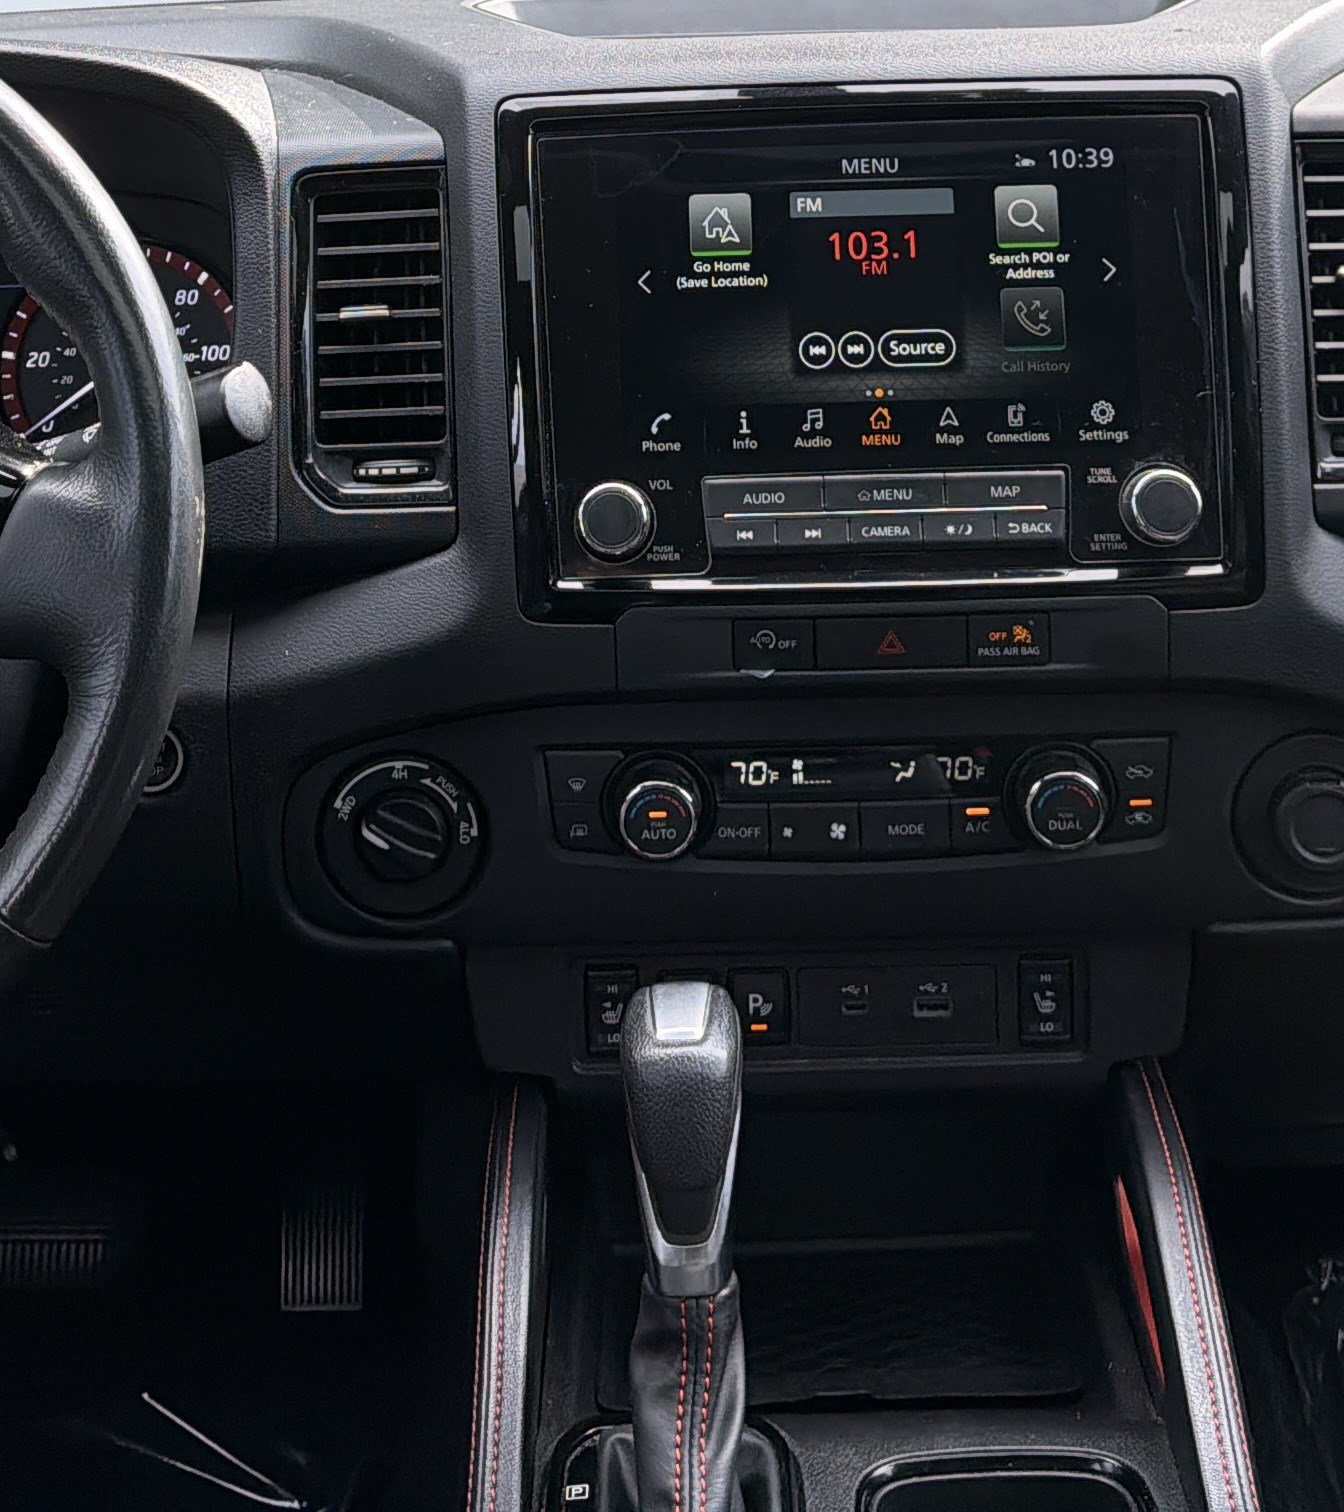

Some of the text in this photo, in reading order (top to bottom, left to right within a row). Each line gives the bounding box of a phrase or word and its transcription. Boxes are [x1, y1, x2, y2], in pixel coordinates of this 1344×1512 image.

[1048, 148, 1114, 169] 10:39
[841, 158, 899, 174] MENU
[796, 197, 823, 212] FM
[828, 230, 917, 261] 103.1
[989, 251, 1070, 266] Search POI or
[693, 259, 751, 273] Go Home
[862, 261, 888, 275] FM
[1006, 267, 1055, 280] Address
[676, 273, 769, 290] (Save Location)
[175, 289, 198, 305] 80
[63, 347, 76, 357] 40
[201, 345, 231, 362] 100
[889, 339, 945, 356] Source
[26, 351, 51, 368] 20
[1002, 359, 1071, 374] Call History
[60, 375, 73, 384] 20
[794, 435, 832, 448] Audio
[862, 433, 901, 446] MENU
[936, 432, 964, 446] Map
[987, 430, 1050, 443] Connections
[1079, 428, 1129, 443] Settings
[642, 439, 681, 453] Phone
[732, 437, 758, 450] Info
[1090, 467, 1112, 476] TUNE
[649, 479, 673, 490] VOL
[1086, 475, 1118, 484] SCROLL
[743, 492, 785, 505] AUDIO
[873, 488, 913, 501] MENU
[990, 486, 1021, 498] MAP
[862, 526, 910, 536] CAMERA
[1021, 522, 1053, 534] BACK
[1094, 533, 1122, 542] ENTER
[653, 545, 674, 553] PUSH
[1090, 541, 1128, 551] SETTING
[646, 552, 681, 561] POWER
[988, 632, 1008, 642] OFF
[778, 640, 797, 650] OFF
[978, 646, 1041, 656] PASS AIR BAG
[391, 769, 408, 780] 4H
[436, 775, 460, 798] PUSH
[338, 795, 357, 821] 2WD
[887, 824, 925, 836] MODE
[965, 821, 990, 833] A/C
[1049, 820, 1083, 831] DUAL
[459, 821, 472, 845] 4LO
[640, 829, 677, 840] AUTO
[1040, 973, 1052, 982] HI
[607, 984, 618, 994] HI
[941, 982, 949, 992] 2
[1040, 1022, 1054, 1032] LO
